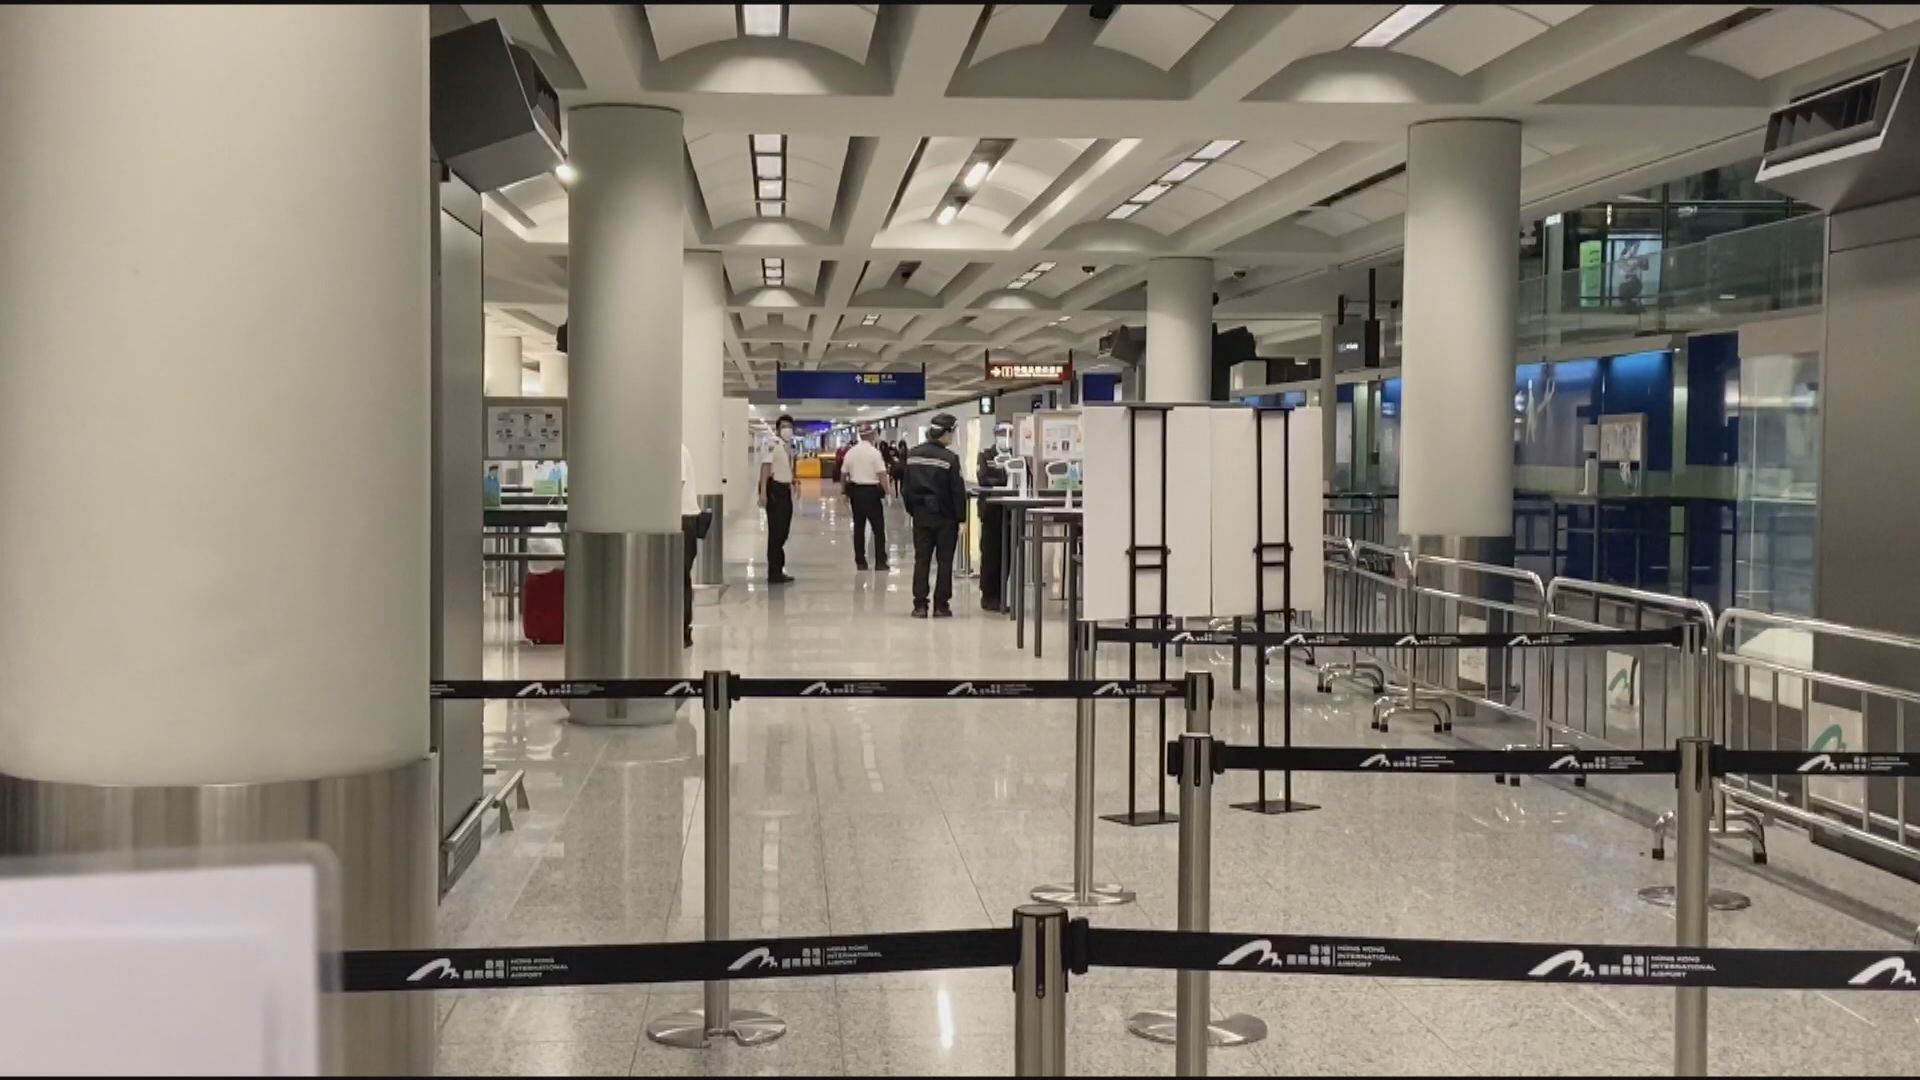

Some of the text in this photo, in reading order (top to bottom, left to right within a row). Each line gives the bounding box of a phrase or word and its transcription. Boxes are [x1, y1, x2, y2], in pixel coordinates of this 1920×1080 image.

[1362, 945, 1386, 953] KONG
[1337, 952, 1401, 961] INTERNATIONAL
[1651, 963, 1716, 971] INTERNATIONAL
